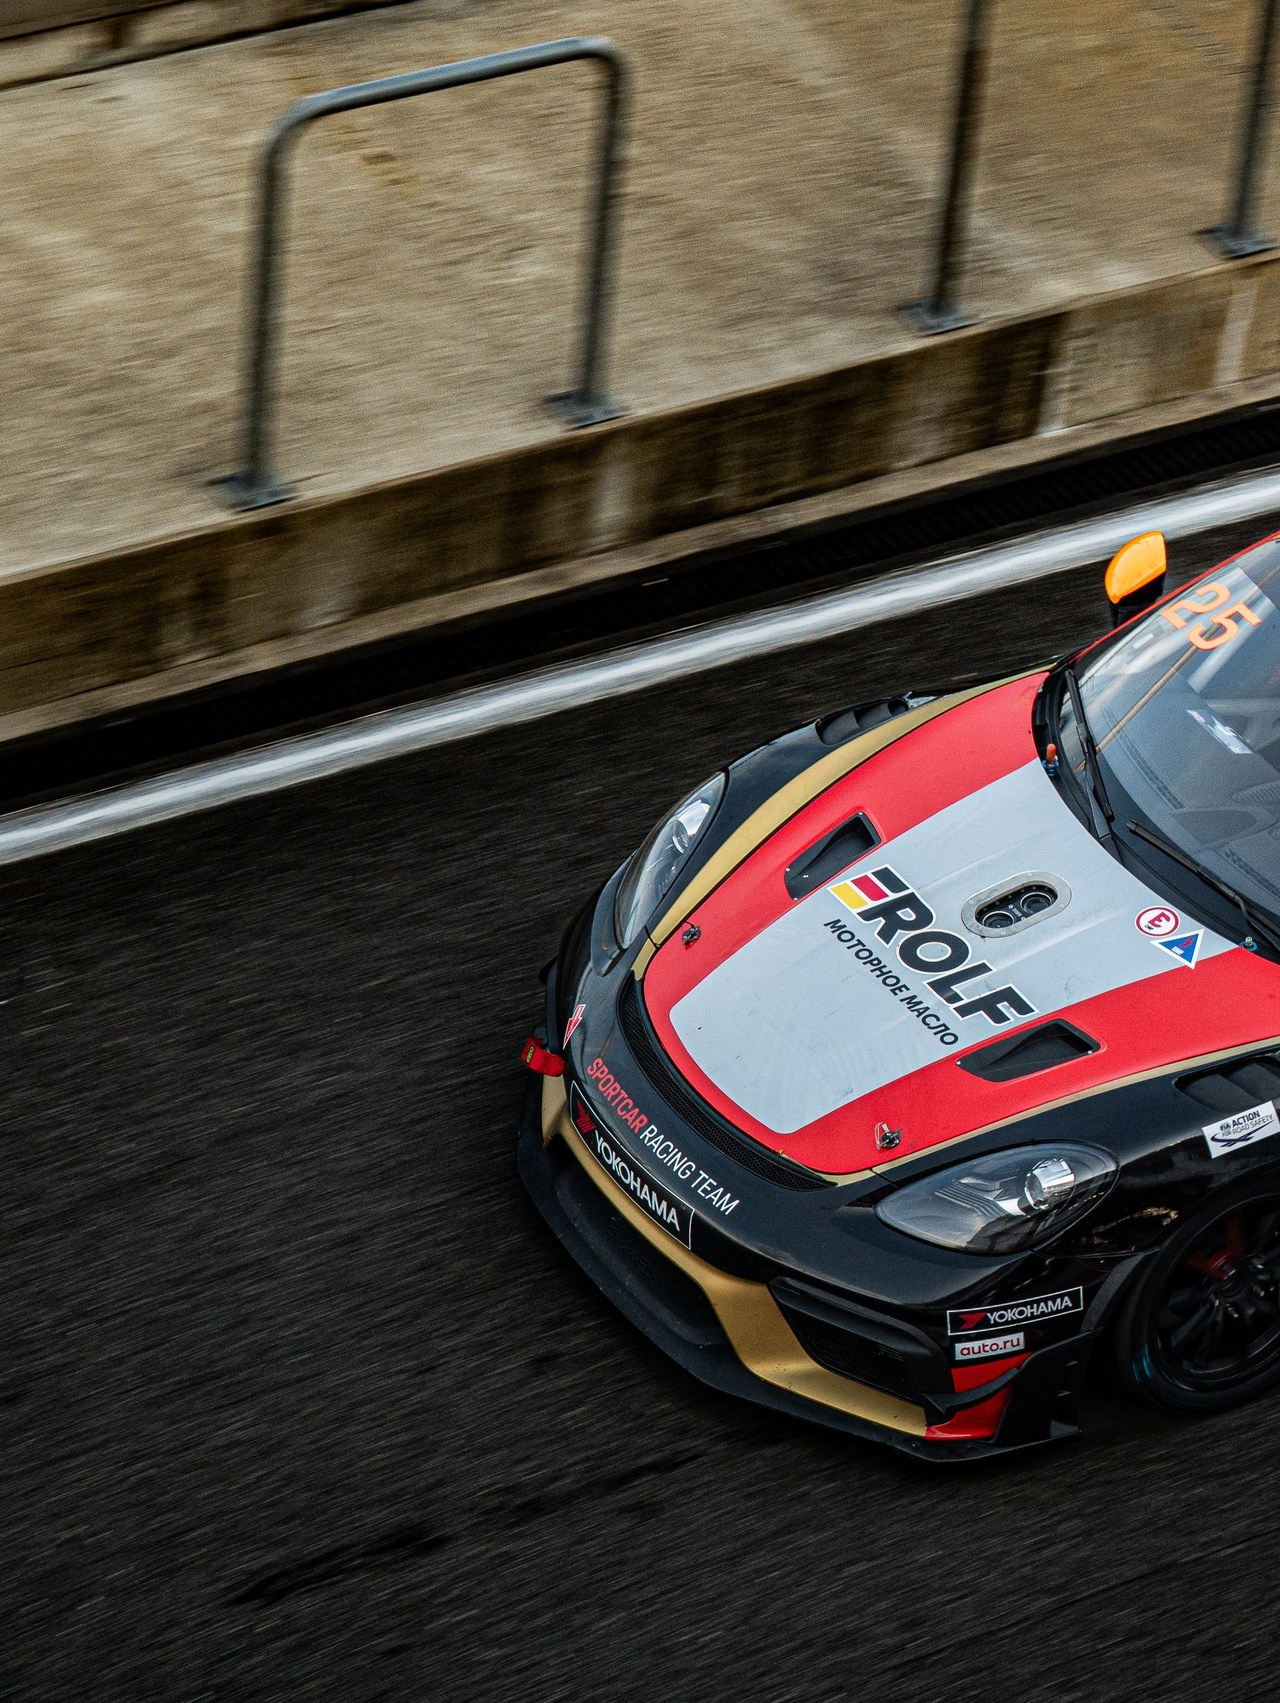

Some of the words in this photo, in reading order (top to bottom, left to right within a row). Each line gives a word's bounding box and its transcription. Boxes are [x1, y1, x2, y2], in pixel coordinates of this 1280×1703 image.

[1159, 582, 1262, 650] 25
[823, 917, 909, 997] МОТОРНОЕ
[899, 993, 959, 1046] МАСЛО
[855, 886, 1040, 1027] ROLF
[586, 1057, 649, 1135] SPORTCAR
[639, 1124, 697, 1180] RACING
[692, 1169, 741, 1217] TEAM
[1231, 1110, 1261, 1128] ACTION
[1231, 1124, 1250, 1136] ROAD
[1249, 1113, 1274, 1128] SAFETY
[594, 1129, 681, 1232] YOKOHAMA
[986, 1294, 1074, 1326] YOKOHAMA
[959, 1335, 1021, 1358] auto.ru
